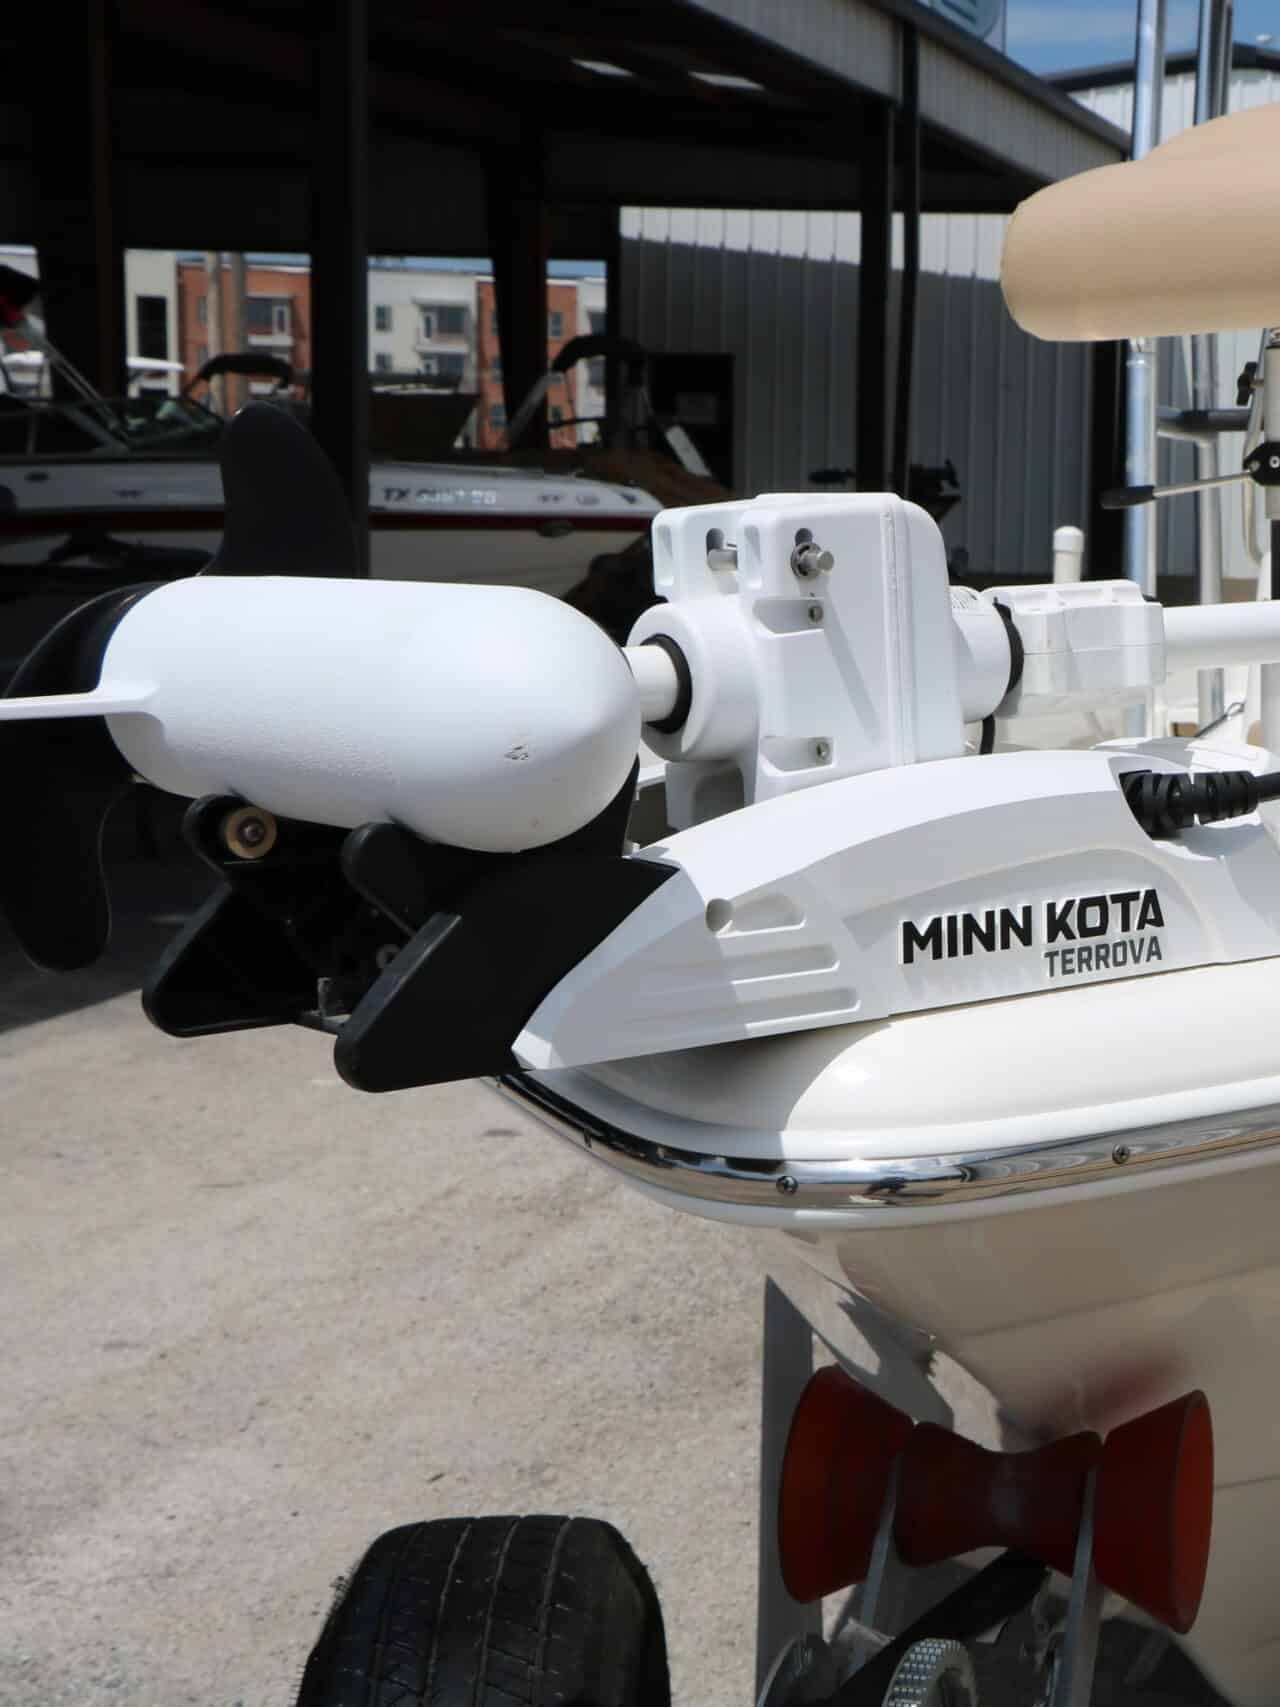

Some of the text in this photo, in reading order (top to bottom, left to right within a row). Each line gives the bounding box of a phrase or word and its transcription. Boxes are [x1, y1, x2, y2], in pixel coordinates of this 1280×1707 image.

[902, 888, 1165, 965] MINN KOTA
[1044, 935, 1163, 977] TERROVA
